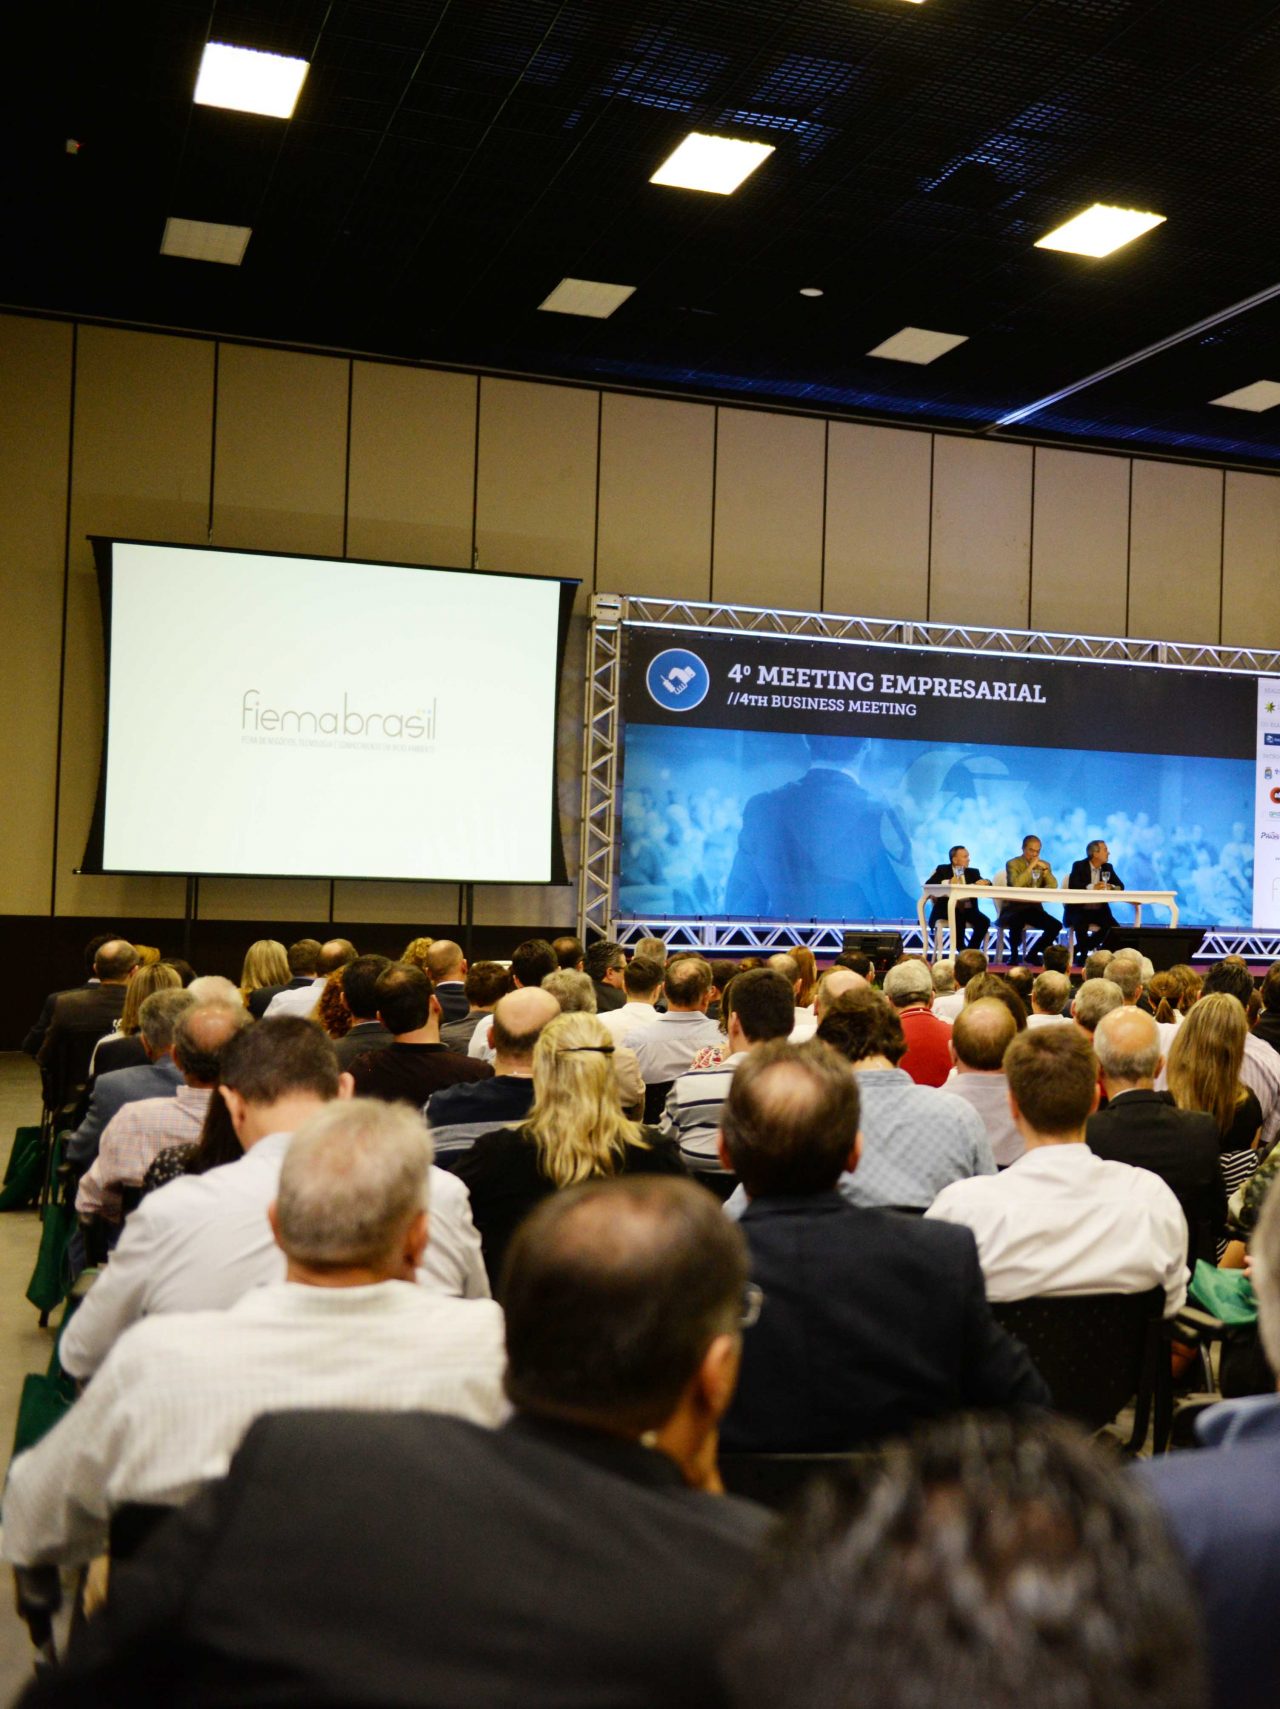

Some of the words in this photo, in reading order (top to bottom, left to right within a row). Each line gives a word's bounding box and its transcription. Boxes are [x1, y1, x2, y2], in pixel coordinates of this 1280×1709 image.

[756, 665, 875, 693] MEETING
[880, 674, 1047, 703] EMPRESARIAL
[241, 688, 437, 740] fiemabrasil
[771, 695, 845, 712] BUSINESS
[848, 700, 917, 717] MEETING
